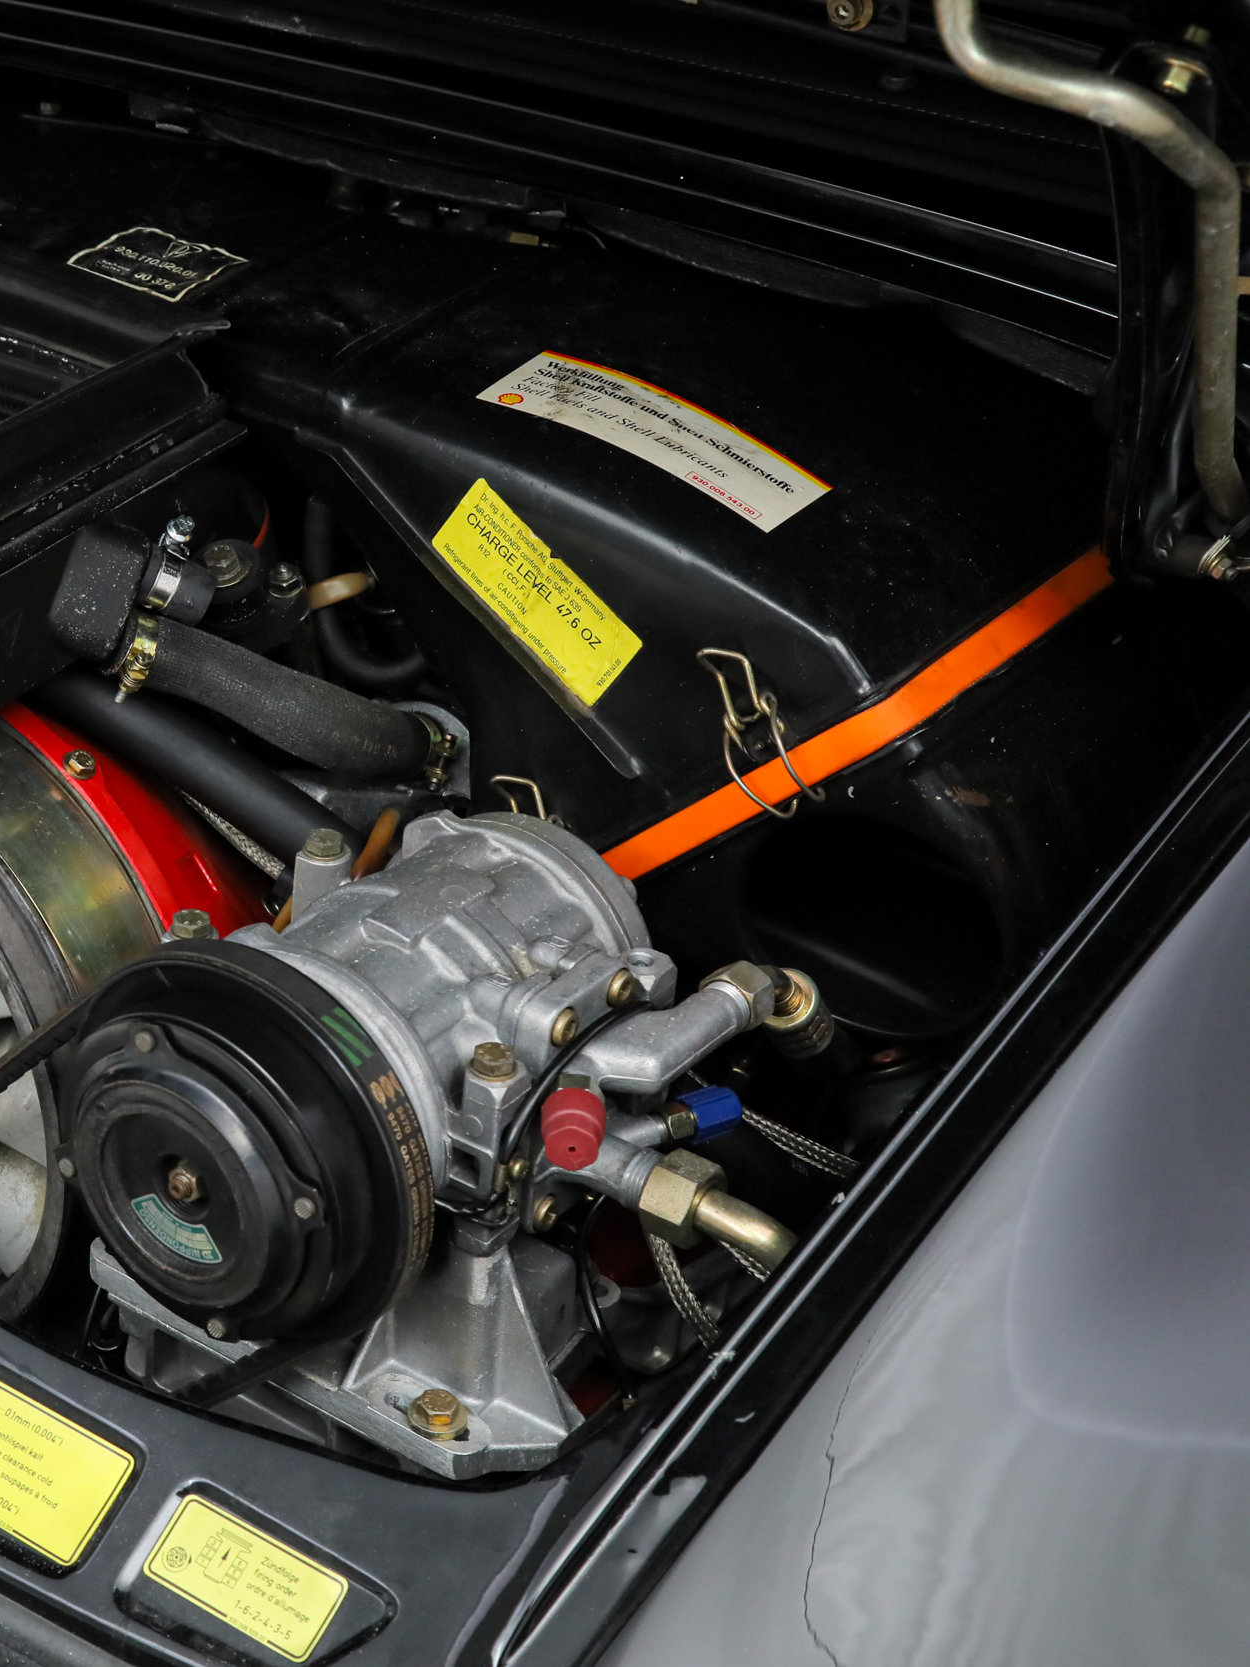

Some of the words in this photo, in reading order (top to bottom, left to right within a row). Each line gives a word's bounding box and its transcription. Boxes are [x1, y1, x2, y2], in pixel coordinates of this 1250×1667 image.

[574, 390, 602, 402] Fill
[511, 383, 551, 397] Shell
[586, 407, 619, 420] and
[616, 418, 656, 437] Shell
[654, 436, 728, 478] Lubricants
[534, 368, 571, 382] Shell
[570, 378, 638, 406] Kraftstoffe
[640, 405, 669, 420] und
[705, 438, 794, 493] Schmierstoffe
[473, 504, 521, 553] AIR-CONDITIONER
[519, 551, 545, 579] conforms
[544, 575, 553, 585] to
[551, 581, 566, 597] SAE
[569, 598, 582, 613] 639
[480, 492, 494, 507] Dr.
[490, 504, 500, 516] Ing.
[499, 512, 510, 526] h.c.
[509, 522, 517, 532] F.
[516, 529, 538, 554] Porsche
[547, 562, 574, 588] Stuttgart
[574, 586, 606, 621] W-Germany
[467, 513, 518, 566] CHARGE
[516, 563, 552, 604] LEVEL
[556, 603, 581, 629] 47.6
[580, 627, 602, 650] OZ
[497, 582, 527, 615] CAUTION
[443, 542, 472, 575] Refrigerant
[470, 571, 484, 588] lines
[483, 585, 491, 594] of
[489, 592, 529, 635] air-conditioning
[527, 632, 545, 650] under
[542, 648, 567, 674] pressure
[401, 1145, 417, 1185] GATES
[138, 1208, 202, 1259] NIPPONDENSO
[2, 1454, 37, 1477] clearance
[36, 1474, 54, 1487] cold
[28, 1448, 44, 1462] kalt
[0, 1472, 34, 1495] soupapes
[33, 1491, 40, 1499] à
[40, 1494, 59, 1510] froid
[253, 1568, 275, 1588] firing
[275, 1583, 297, 1597] order
[260, 1556, 300, 1584] Zündfolge
[235, 1599, 292, 1640] 1-6-2-4-3-5
[246, 1582, 267, 1598] ordre
[267, 1595, 310, 1623] d'allumage
